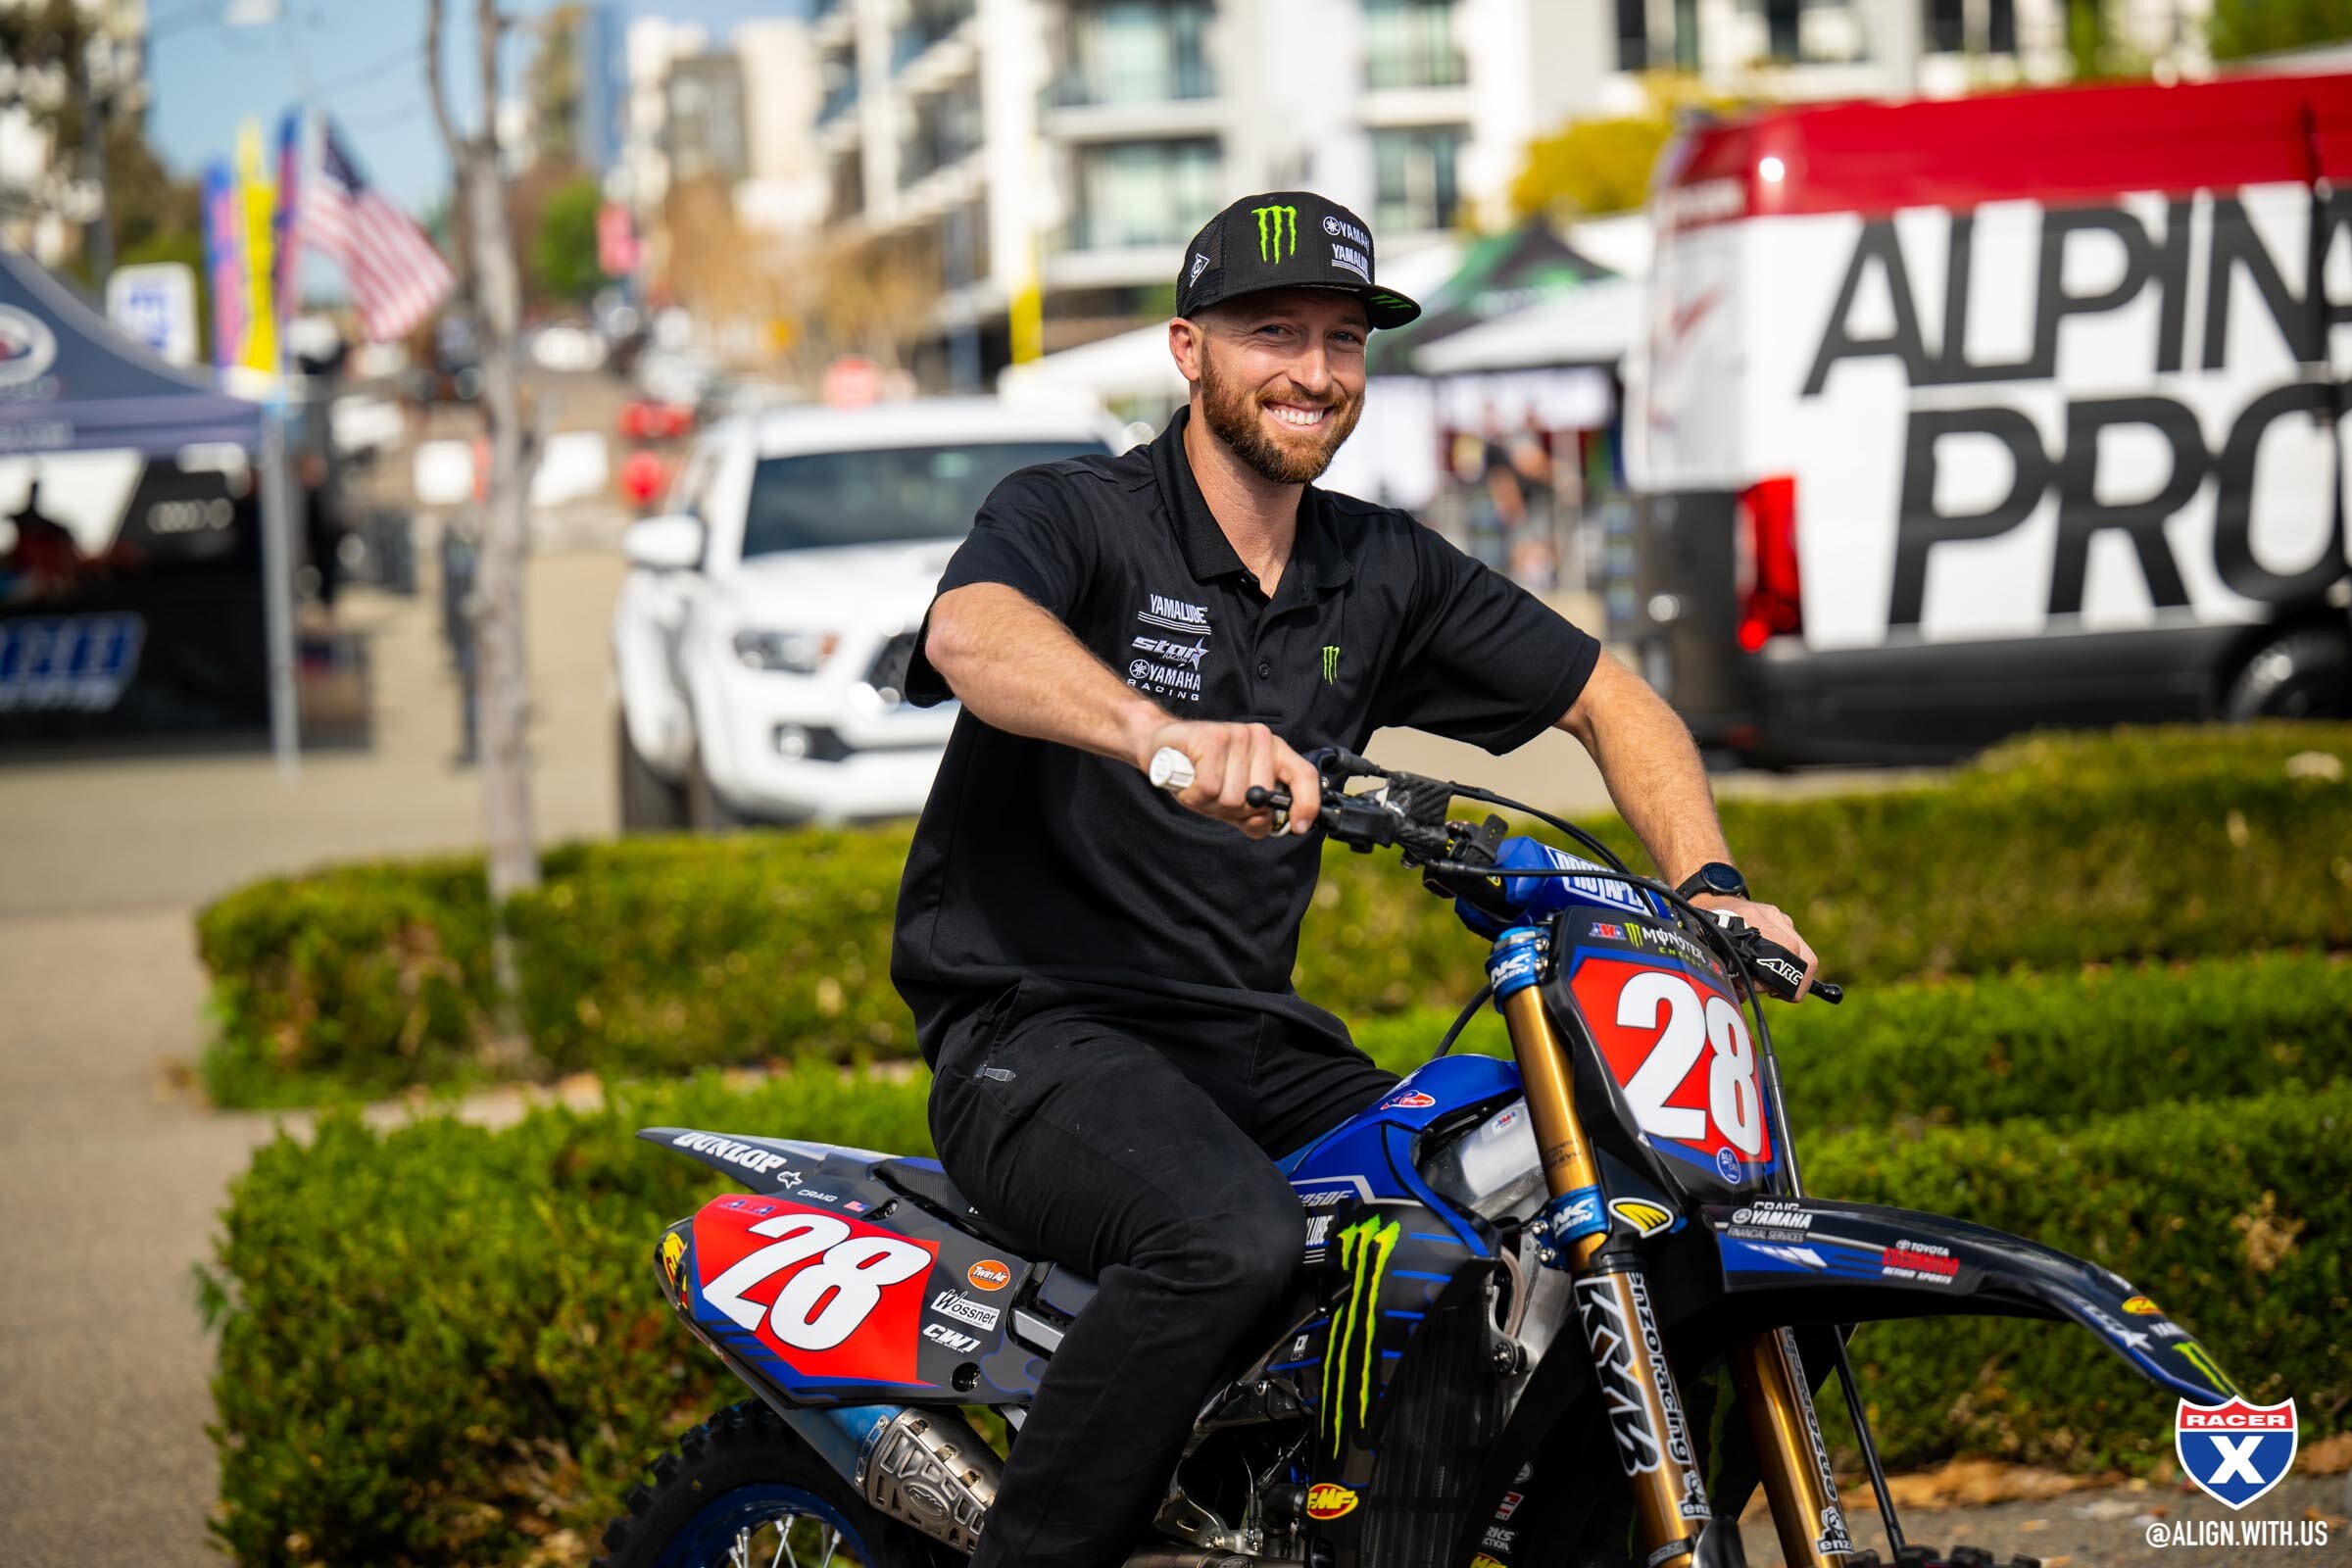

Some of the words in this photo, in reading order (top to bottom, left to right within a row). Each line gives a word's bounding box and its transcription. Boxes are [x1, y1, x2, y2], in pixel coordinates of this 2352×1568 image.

[1886, 380, 2352, 625] PRO
[1151, 594, 1207, 623] YAMALUBE
[1149, 663, 1201, 692] YAMAHA
[1127, 678, 1200, 702] RACING
[1642, 926, 1706, 964] MONSTER
[1756, 957, 1804, 986] ARC
[1615, 970, 1762, 1156] 28
[672, 1131, 788, 1174] DUNLOP
[797, 1188, 838, 1202] CRAIG
[1750, 1210, 1813, 1229] YAMAHA
[1727, 1227, 1766, 1240] FINANCIAL
[1768, 1230, 1804, 1242] SERVICES
[1911, 1242, 1949, 1256] TOYOTA
[703, 1212, 932, 1350] 28
[972, 1265, 994, 1281] Twin
[994, 1270, 1008, 1283] Air
[1307, 1488, 1356, 1510] FMF
[1683, 1504, 1710, 1516] enz
[1486, 1526, 1515, 1542] RKS
[1819, 1541, 1851, 1551] enz
